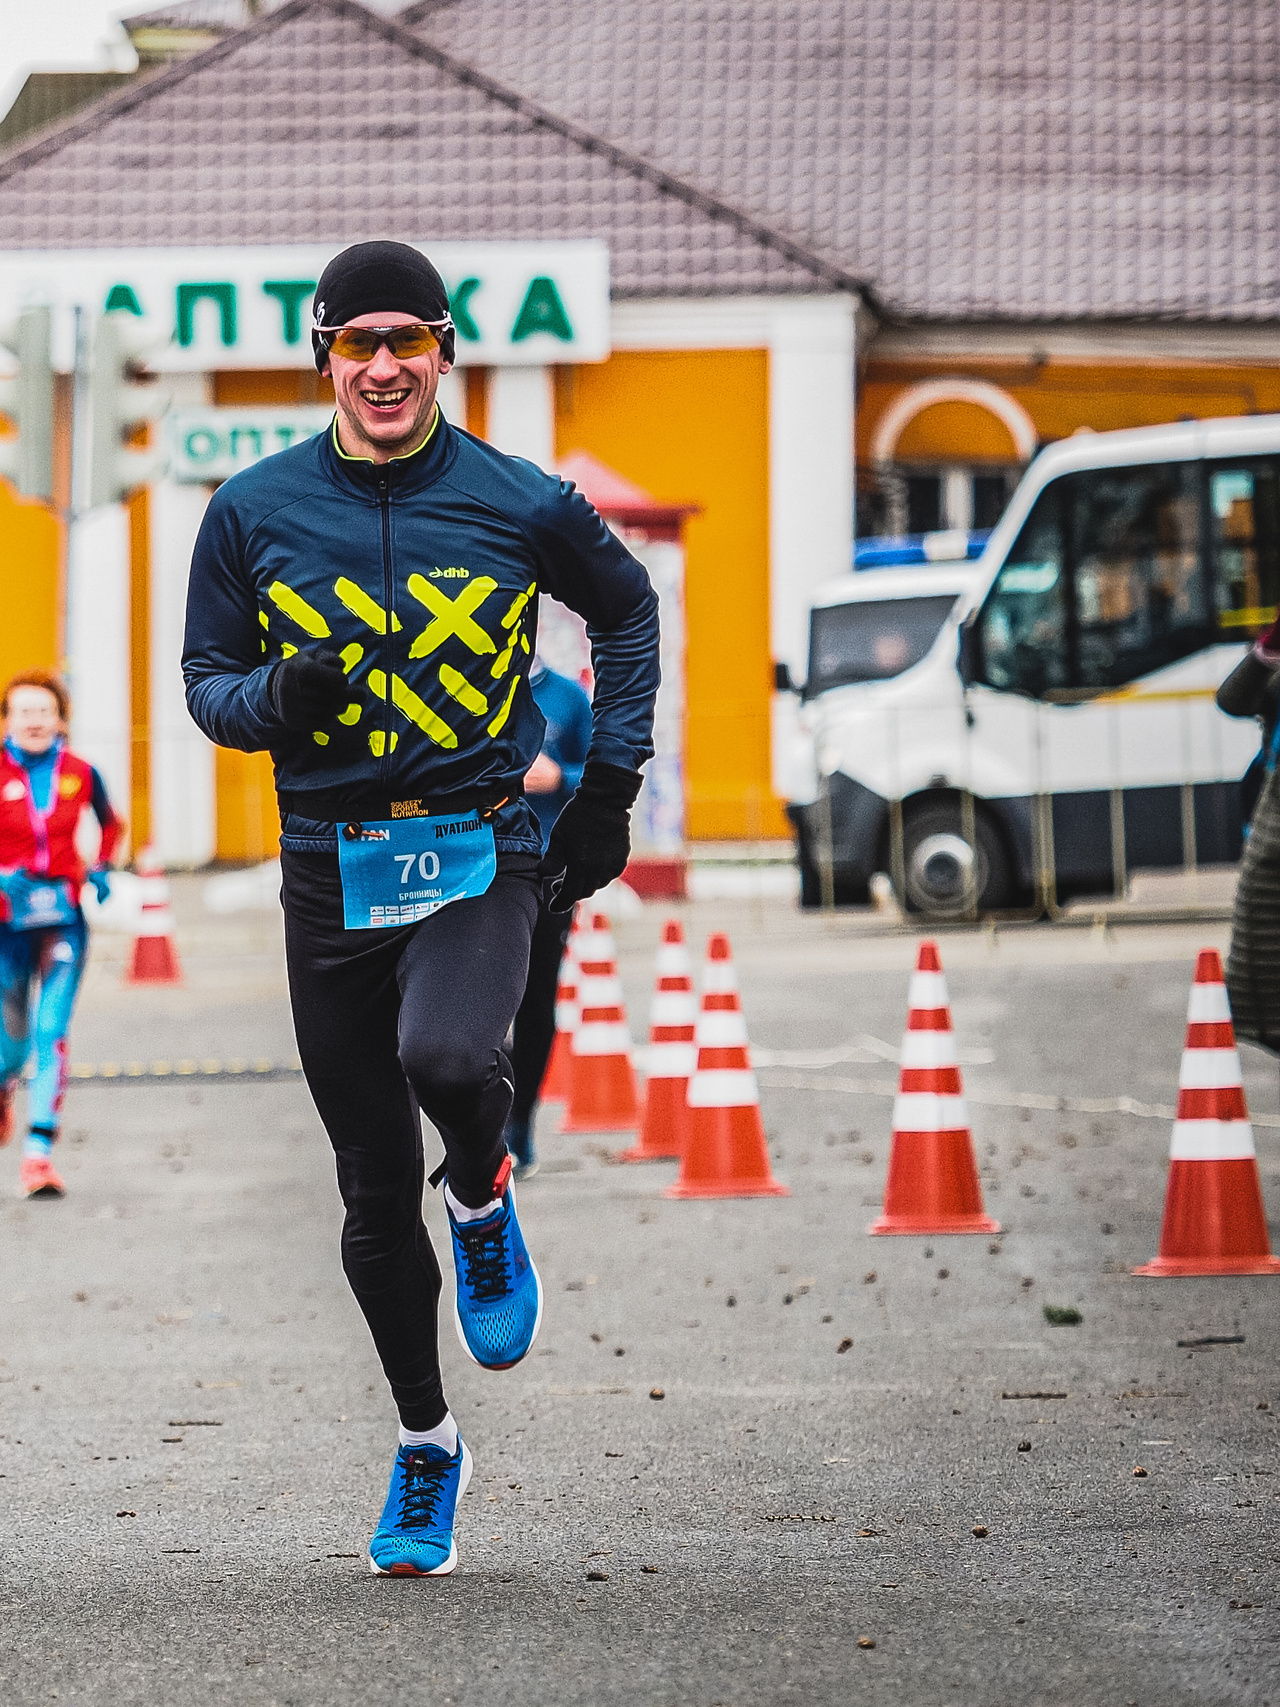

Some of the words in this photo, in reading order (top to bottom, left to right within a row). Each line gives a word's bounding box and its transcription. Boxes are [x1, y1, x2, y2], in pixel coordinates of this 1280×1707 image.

[104, 277, 574, 346] АПТКА
[184, 424, 321, 463] ОПТ
[443, 567, 470, 578] dhb
[391, 809, 429, 818] NUTRITION
[435, 819, 483, 839] ДУАТЛОН
[394, 851, 441, 884] 70
[398, 888, 443, 901] БРОННИЦЫ
